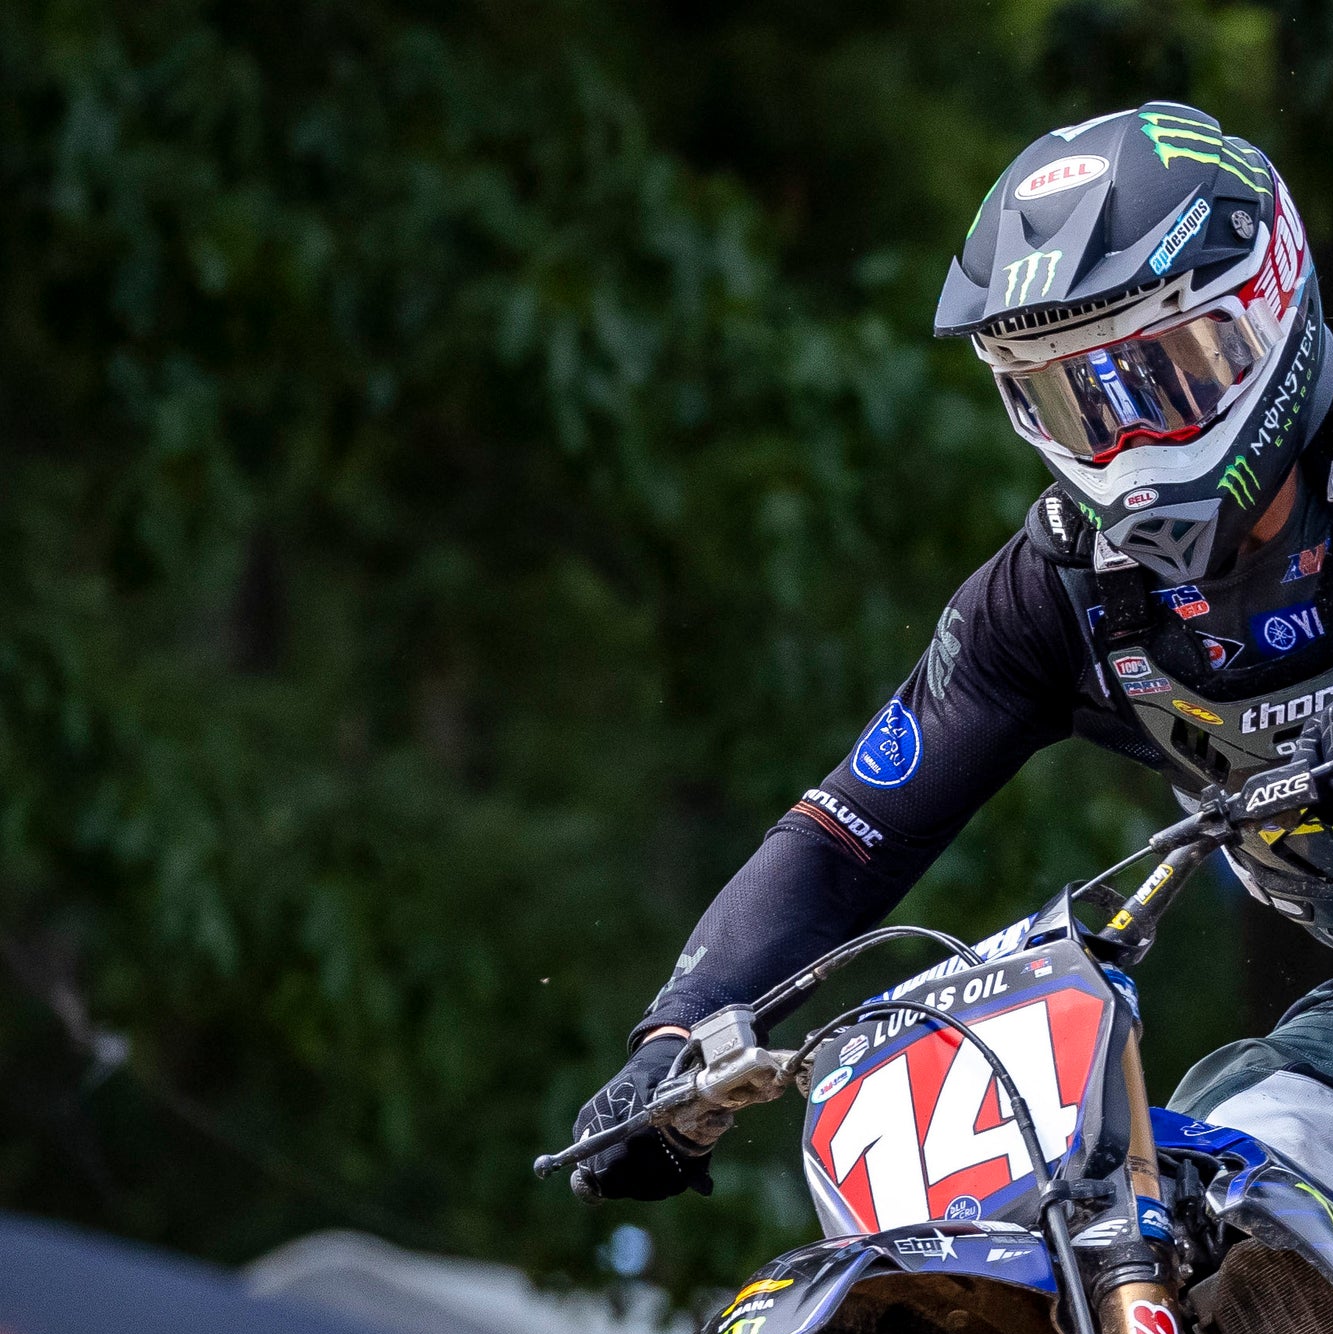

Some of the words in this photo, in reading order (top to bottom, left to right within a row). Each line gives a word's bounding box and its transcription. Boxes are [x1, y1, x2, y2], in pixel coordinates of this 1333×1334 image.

[1030, 162, 1092, 192] BELL
[1044, 496, 1068, 542] thor
[1127, 493, 1154, 506] BELL
[1119, 660, 1148, 675] 100%
[1246, 772, 1311, 812] ARC
[873, 986, 956, 1048] LUCAS
[962, 970, 1009, 1004] OIL
[829, 999, 1079, 1232] 14
